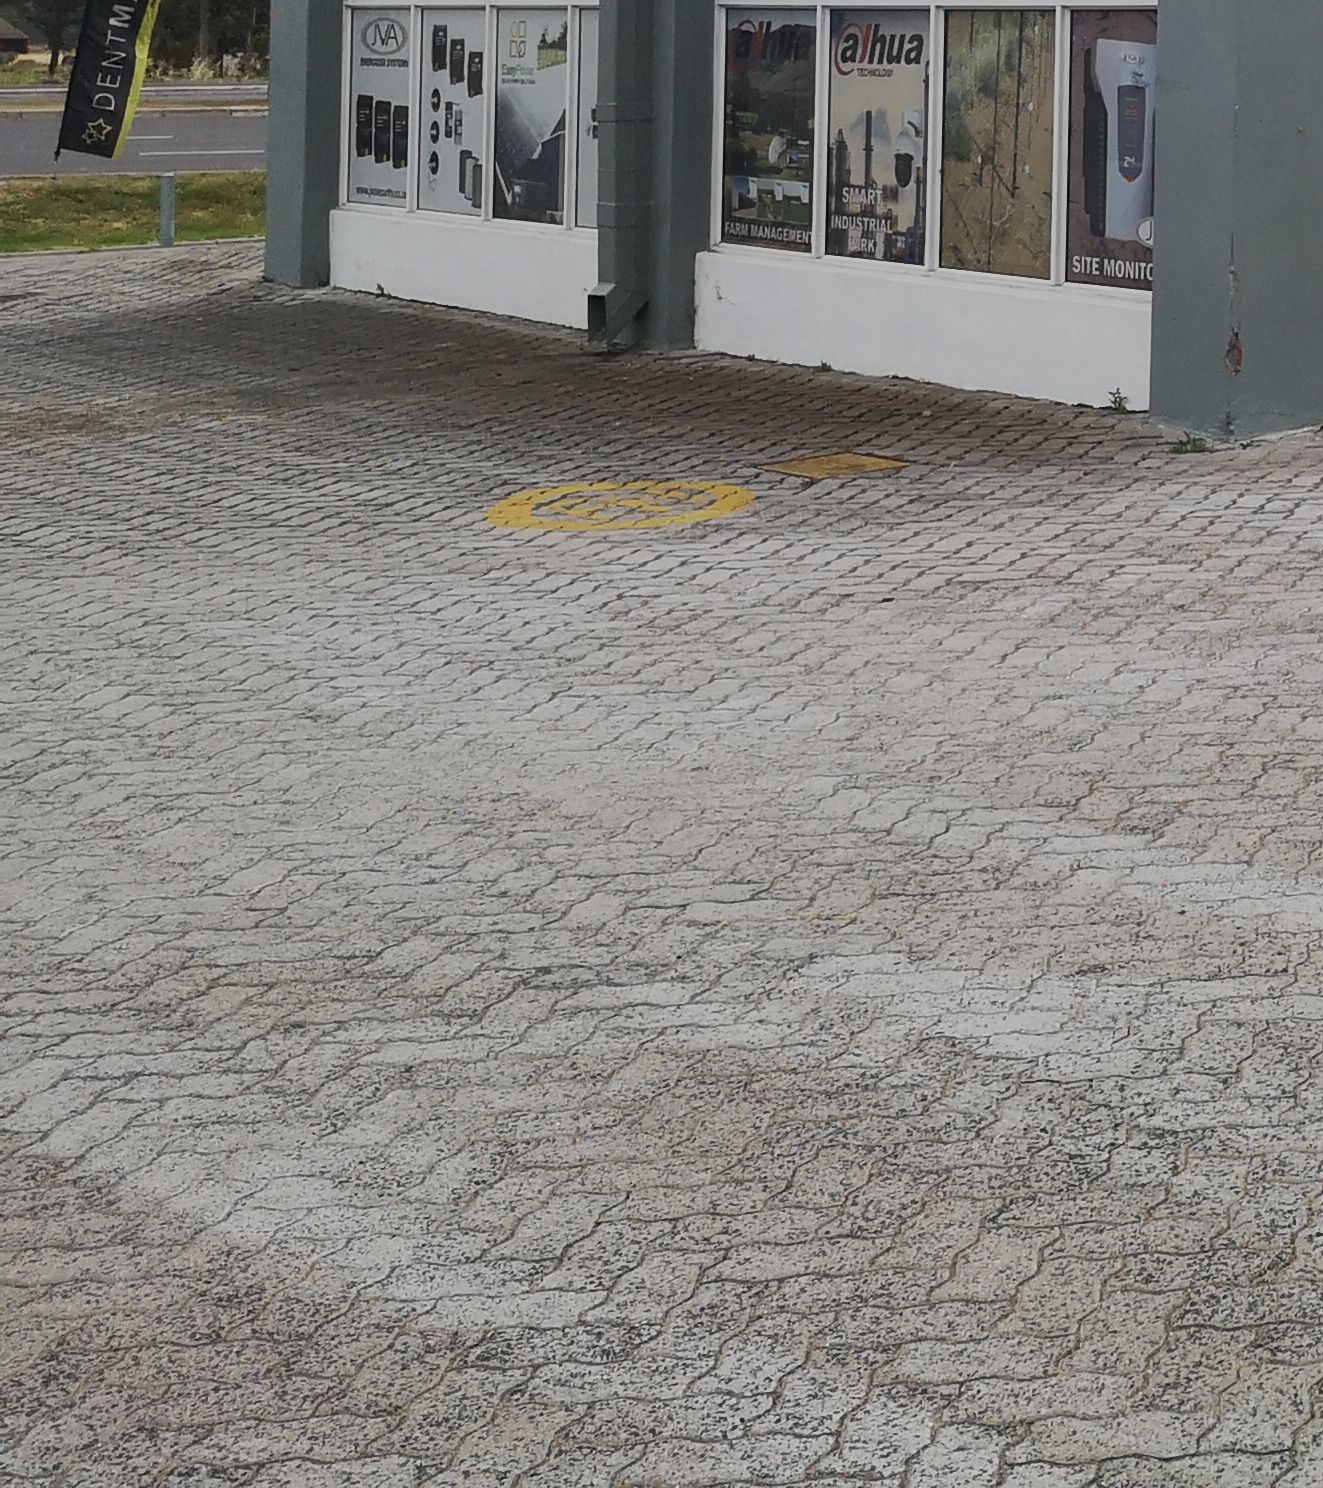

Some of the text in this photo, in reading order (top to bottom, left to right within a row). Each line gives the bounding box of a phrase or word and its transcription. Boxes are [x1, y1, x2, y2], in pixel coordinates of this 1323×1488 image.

[842, 187, 883, 207] SMART
[724, 221, 749, 236] FARM
[830, 215, 893, 234] INDUSTRIAL
[1072, 255, 1154, 281] SITE MONITO
